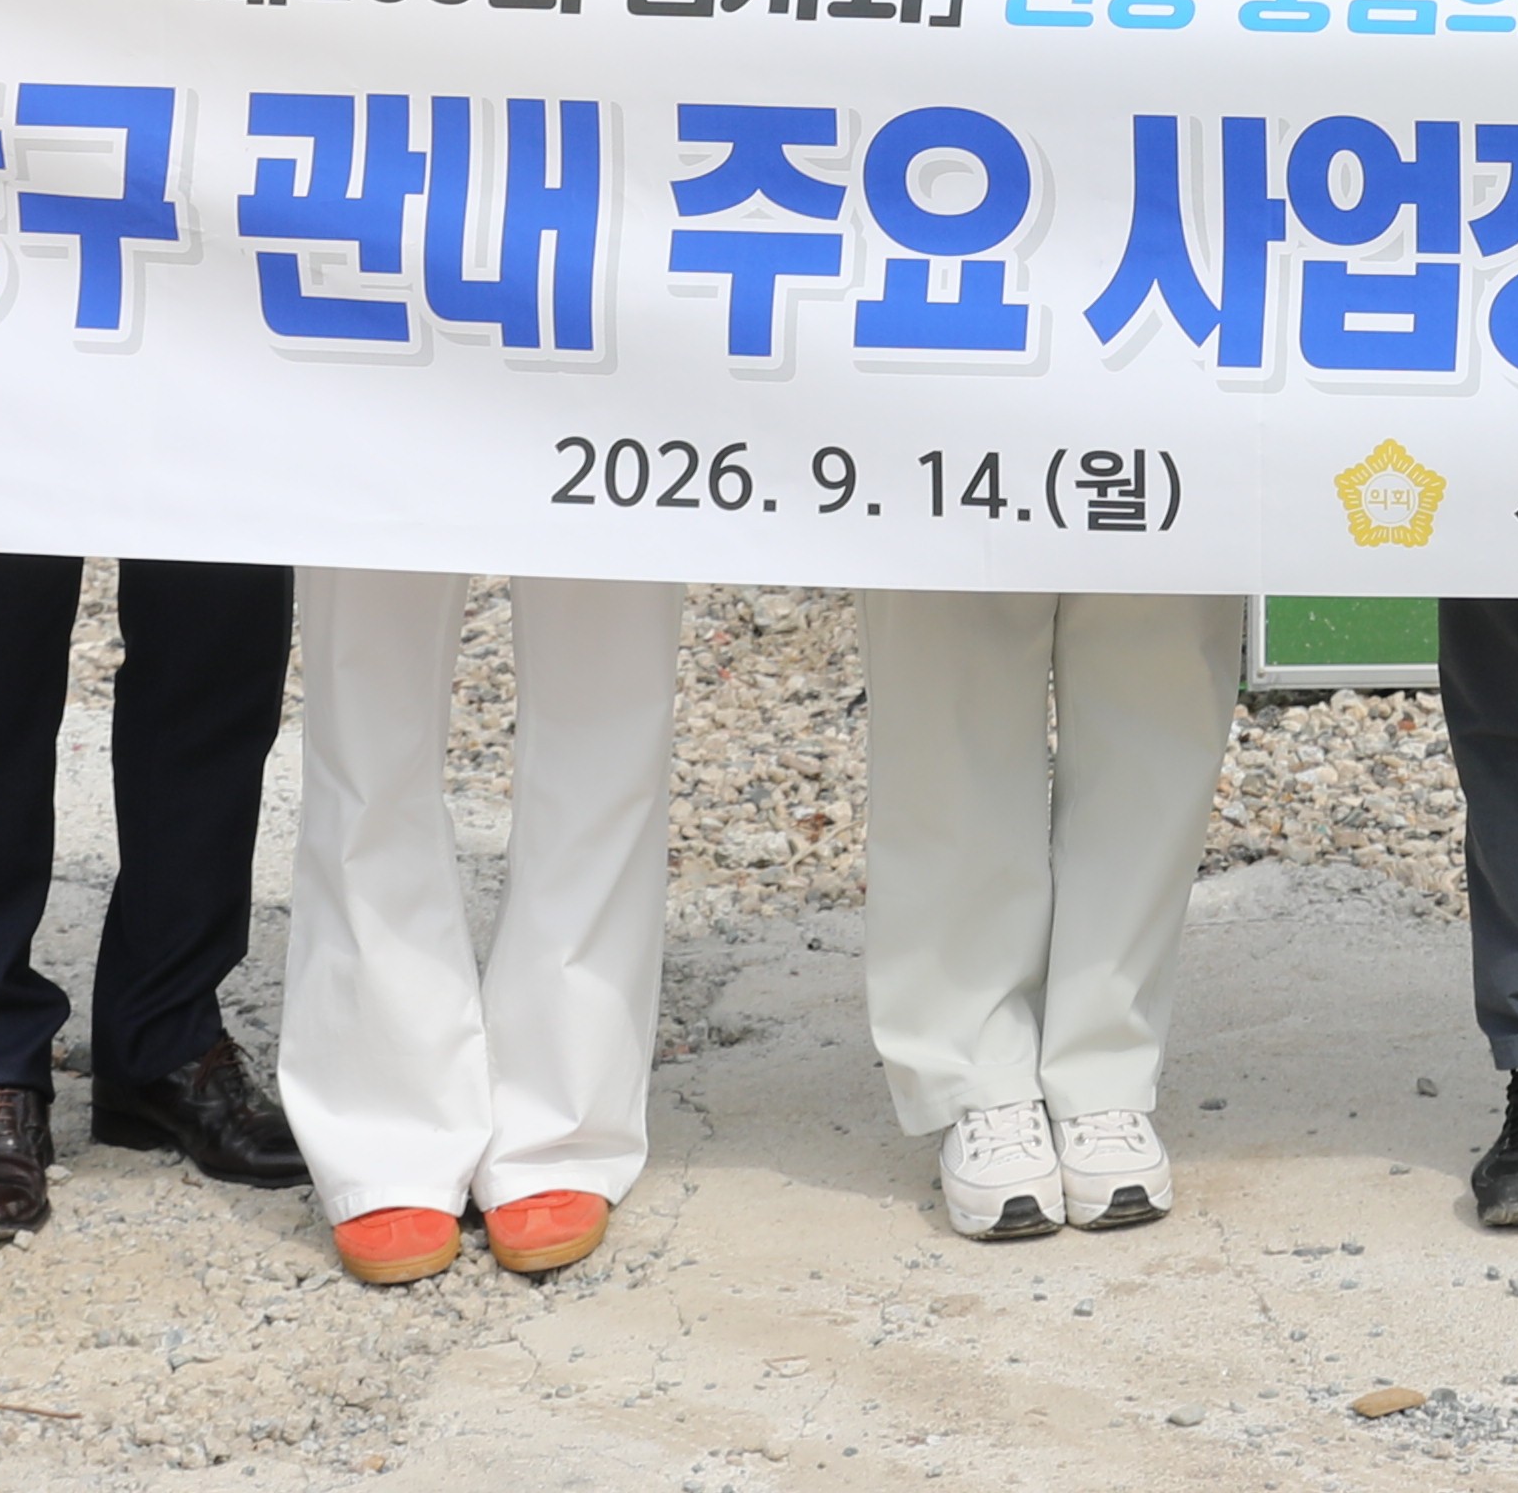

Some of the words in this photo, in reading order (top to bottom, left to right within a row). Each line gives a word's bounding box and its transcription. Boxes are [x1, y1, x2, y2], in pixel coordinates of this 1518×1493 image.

[237, 91, 602, 353] 관내
[667, 102, 1032, 358] 주요
[551, 436, 777, 513] 2026.
[810, 445, 882, 517] 9.
[1366, 482, 1411, 513] 의회
